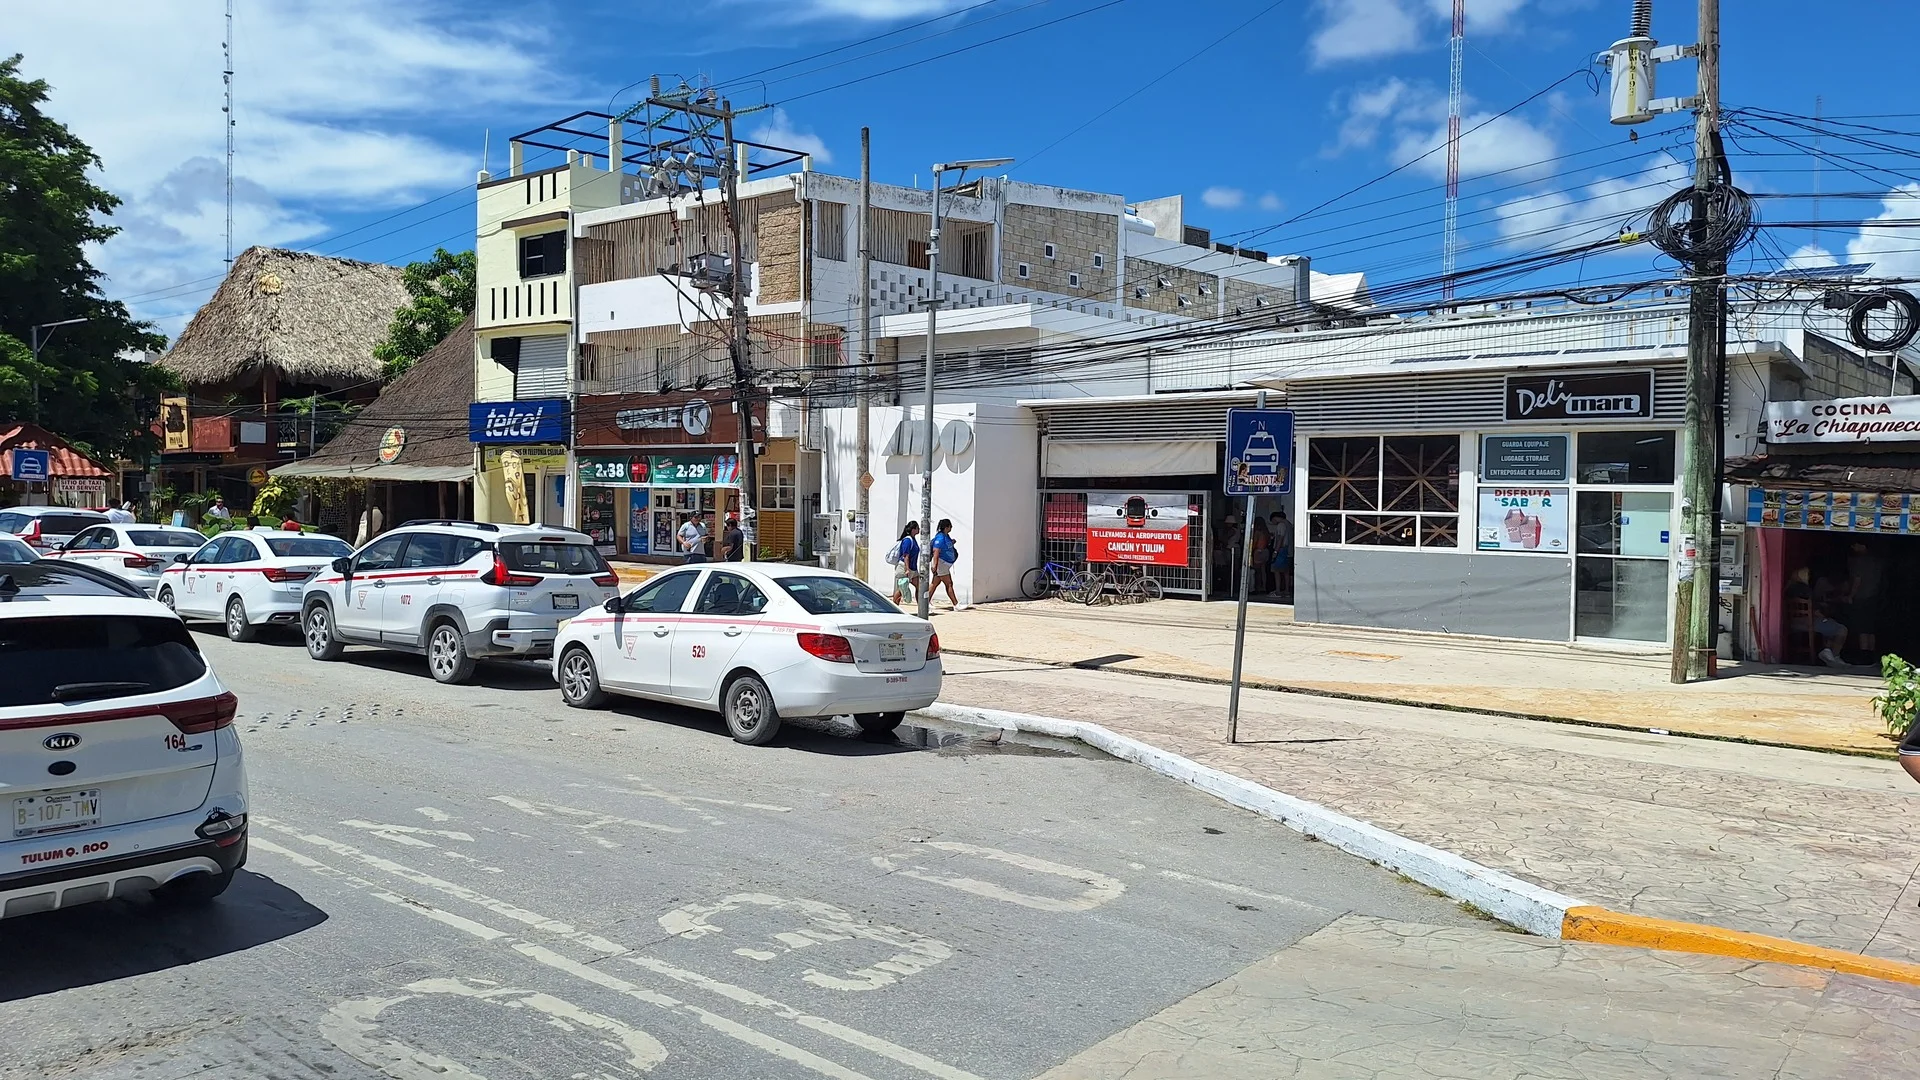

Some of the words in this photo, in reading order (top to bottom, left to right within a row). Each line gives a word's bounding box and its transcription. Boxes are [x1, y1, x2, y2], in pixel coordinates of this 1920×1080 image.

[1515, 379, 1572, 416] Deli
[1570, 395, 1635, 412] mart
[1811, 403, 1891, 417] COCINA
[485, 407, 543, 437] telcel
[1523, 440, 1550, 449] EQUIPAJE
[1500, 454, 1524, 462] LUGGAGE
[1525, 454, 1550, 462] STORAGE
[1489, 468, 1527, 476] ENTREPOSAGE
[1535, 468, 1561, 476] BAGAGES
[1494, 489, 1551, 497] DISFRUTA
[1099, 531, 1126, 539] LLEVAMOS
[1136, 532, 1172, 540] AEROPUERTO
[1107, 540, 1134, 552] CANCÚN
[1135, 543, 1141, 552] Y
[1141, 543, 1165, 553] TULUM
[692, 645, 706, 658] 529
[50, 738, 76, 748] KIA
[164, 734, 187, 750] 164
[18, 799, 98, 825] B-107-TMV
[21, 849, 64, 865] TULUM
[65, 847, 79, 857] Q.
[82, 841, 109, 854] ROO
